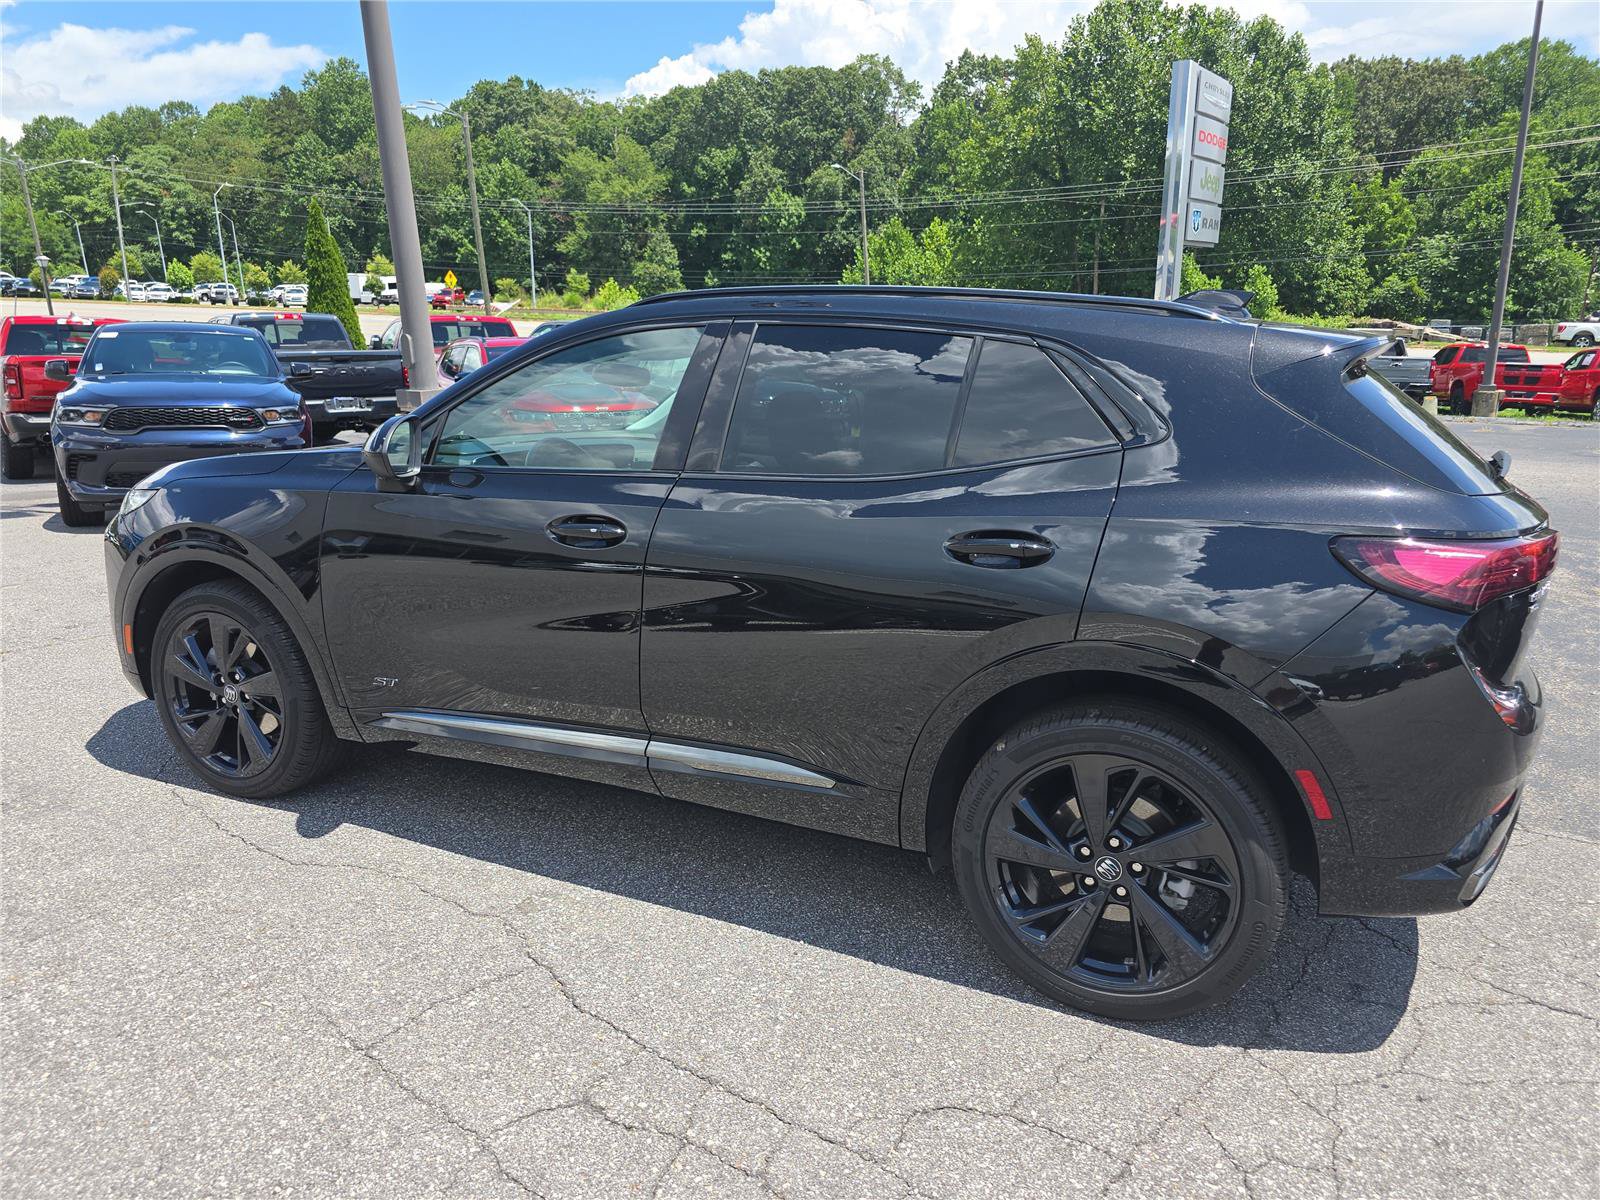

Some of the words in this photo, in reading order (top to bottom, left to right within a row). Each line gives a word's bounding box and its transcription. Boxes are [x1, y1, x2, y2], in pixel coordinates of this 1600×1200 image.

[1199, 130, 1226, 149] DODGE
[1200, 167, 1219, 197] Jeep
[372, 676, 398, 687] ST
[963, 773, 994, 832] Continental
